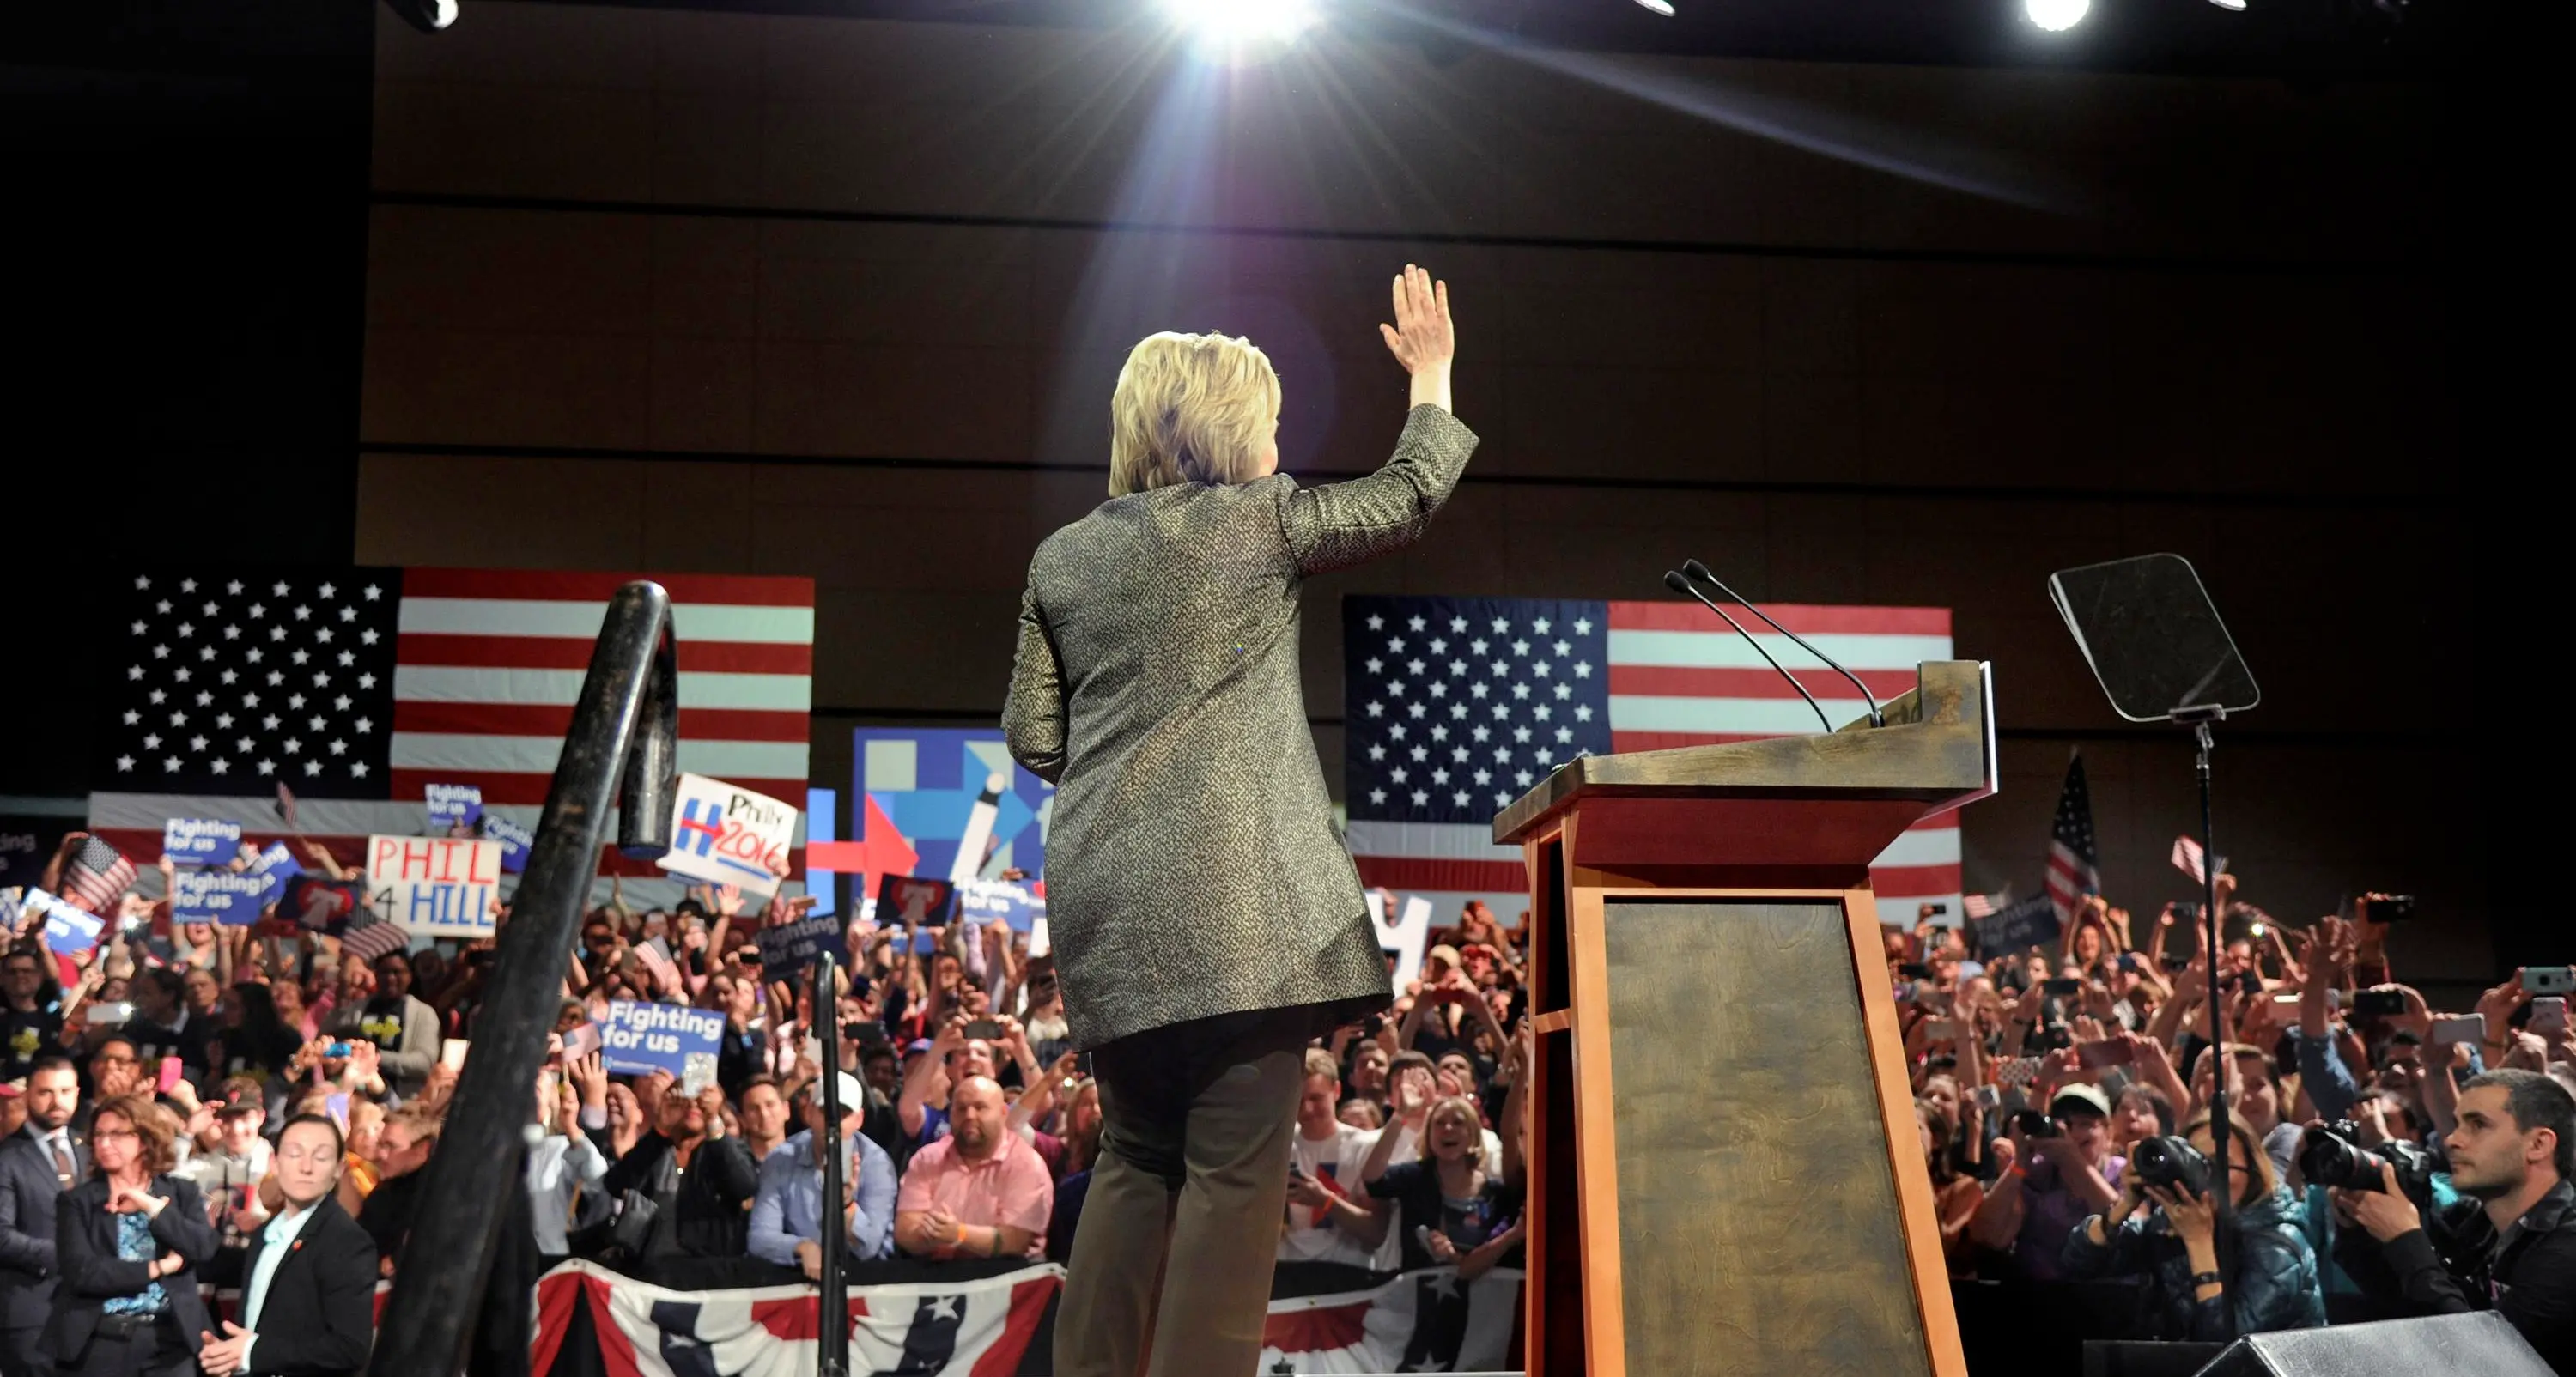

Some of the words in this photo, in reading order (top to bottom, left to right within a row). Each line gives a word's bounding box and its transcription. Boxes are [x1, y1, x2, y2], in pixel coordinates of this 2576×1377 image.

[425, 783, 482, 805] Fighting
[727, 792, 784, 826] Philly
[163, 834, 191, 852] for
[193, 838, 216, 852] us
[166, 817, 240, 841] Fighting
[374, 838, 495, 884] PHIL
[716, 820, 784, 872] 2016
[174, 889, 206, 908] for
[206, 894, 233, 909] us
[175, 871, 261, 897] Fighting
[374, 886, 398, 924] 4
[409, 883, 495, 927] HILL
[609, 999, 724, 1042] Fighting
[602, 1023, 644, 1050] for
[646, 1033, 680, 1053] us
